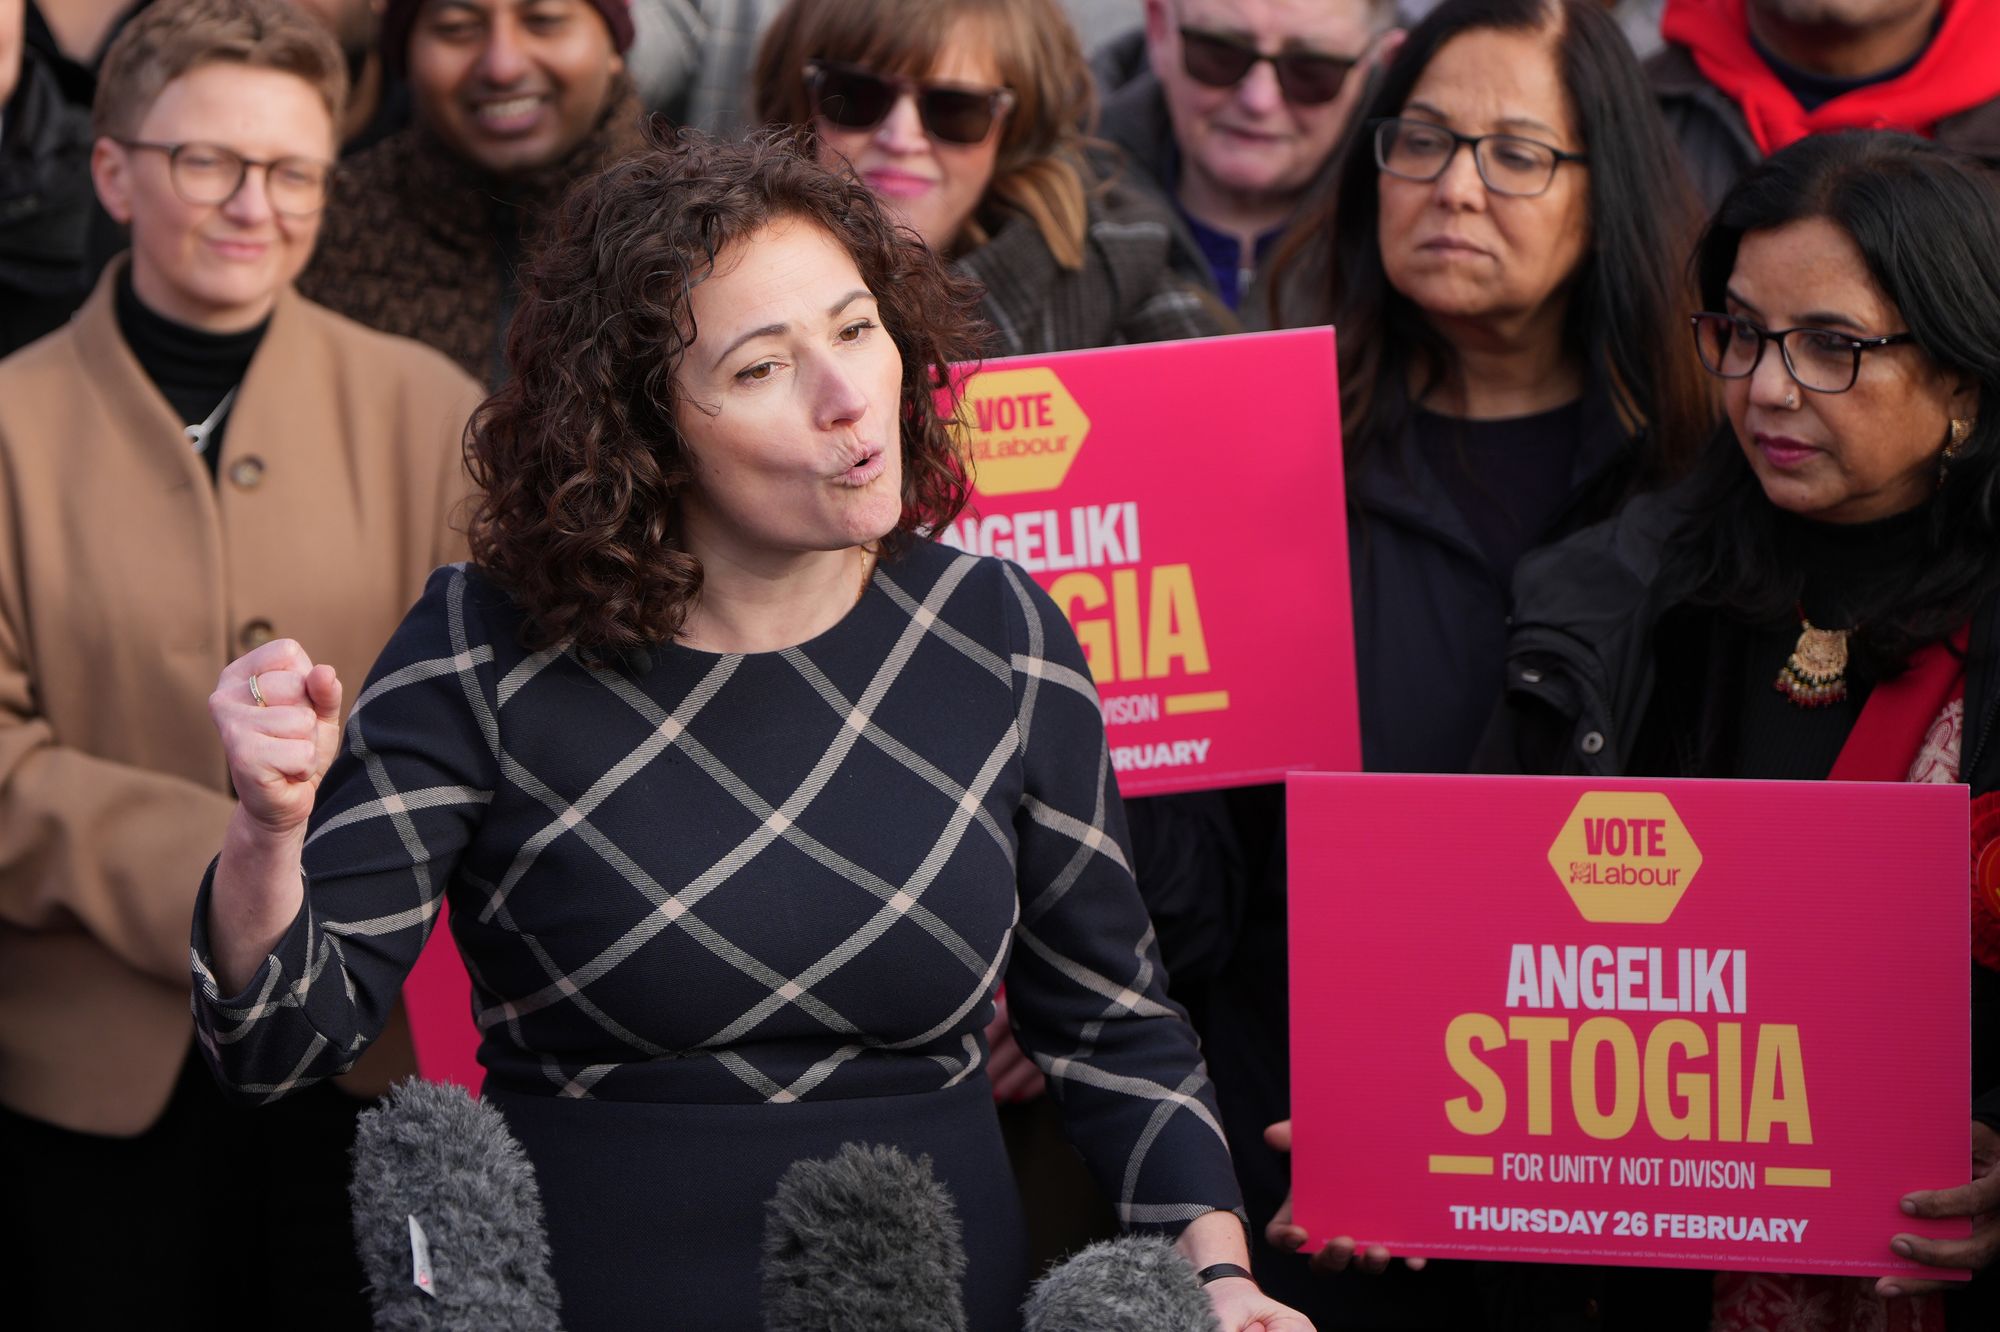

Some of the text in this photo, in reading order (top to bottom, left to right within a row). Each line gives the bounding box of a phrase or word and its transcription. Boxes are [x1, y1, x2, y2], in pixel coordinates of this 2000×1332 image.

[974, 392, 1054, 432] VOTE
[985, 434, 1069, 460] Labour
[934, 502, 1141, 575] NGELIKI
[1048, 563, 1211, 687] GIA
[1110, 738, 1211, 772] RUARY
[1583, 817, 1667, 857] VOTE
[1592, 862, 1681, 887] Labour
[1505, 943, 1747, 1014] ANGELIKI
[1444, 1012, 1813, 1145] STOGIA
[1502, 1152, 1756, 1190] FOR UNITY NOT DIVISON
[1449, 1205, 1809, 1243] THURSDAY 26 FEBRUARY
